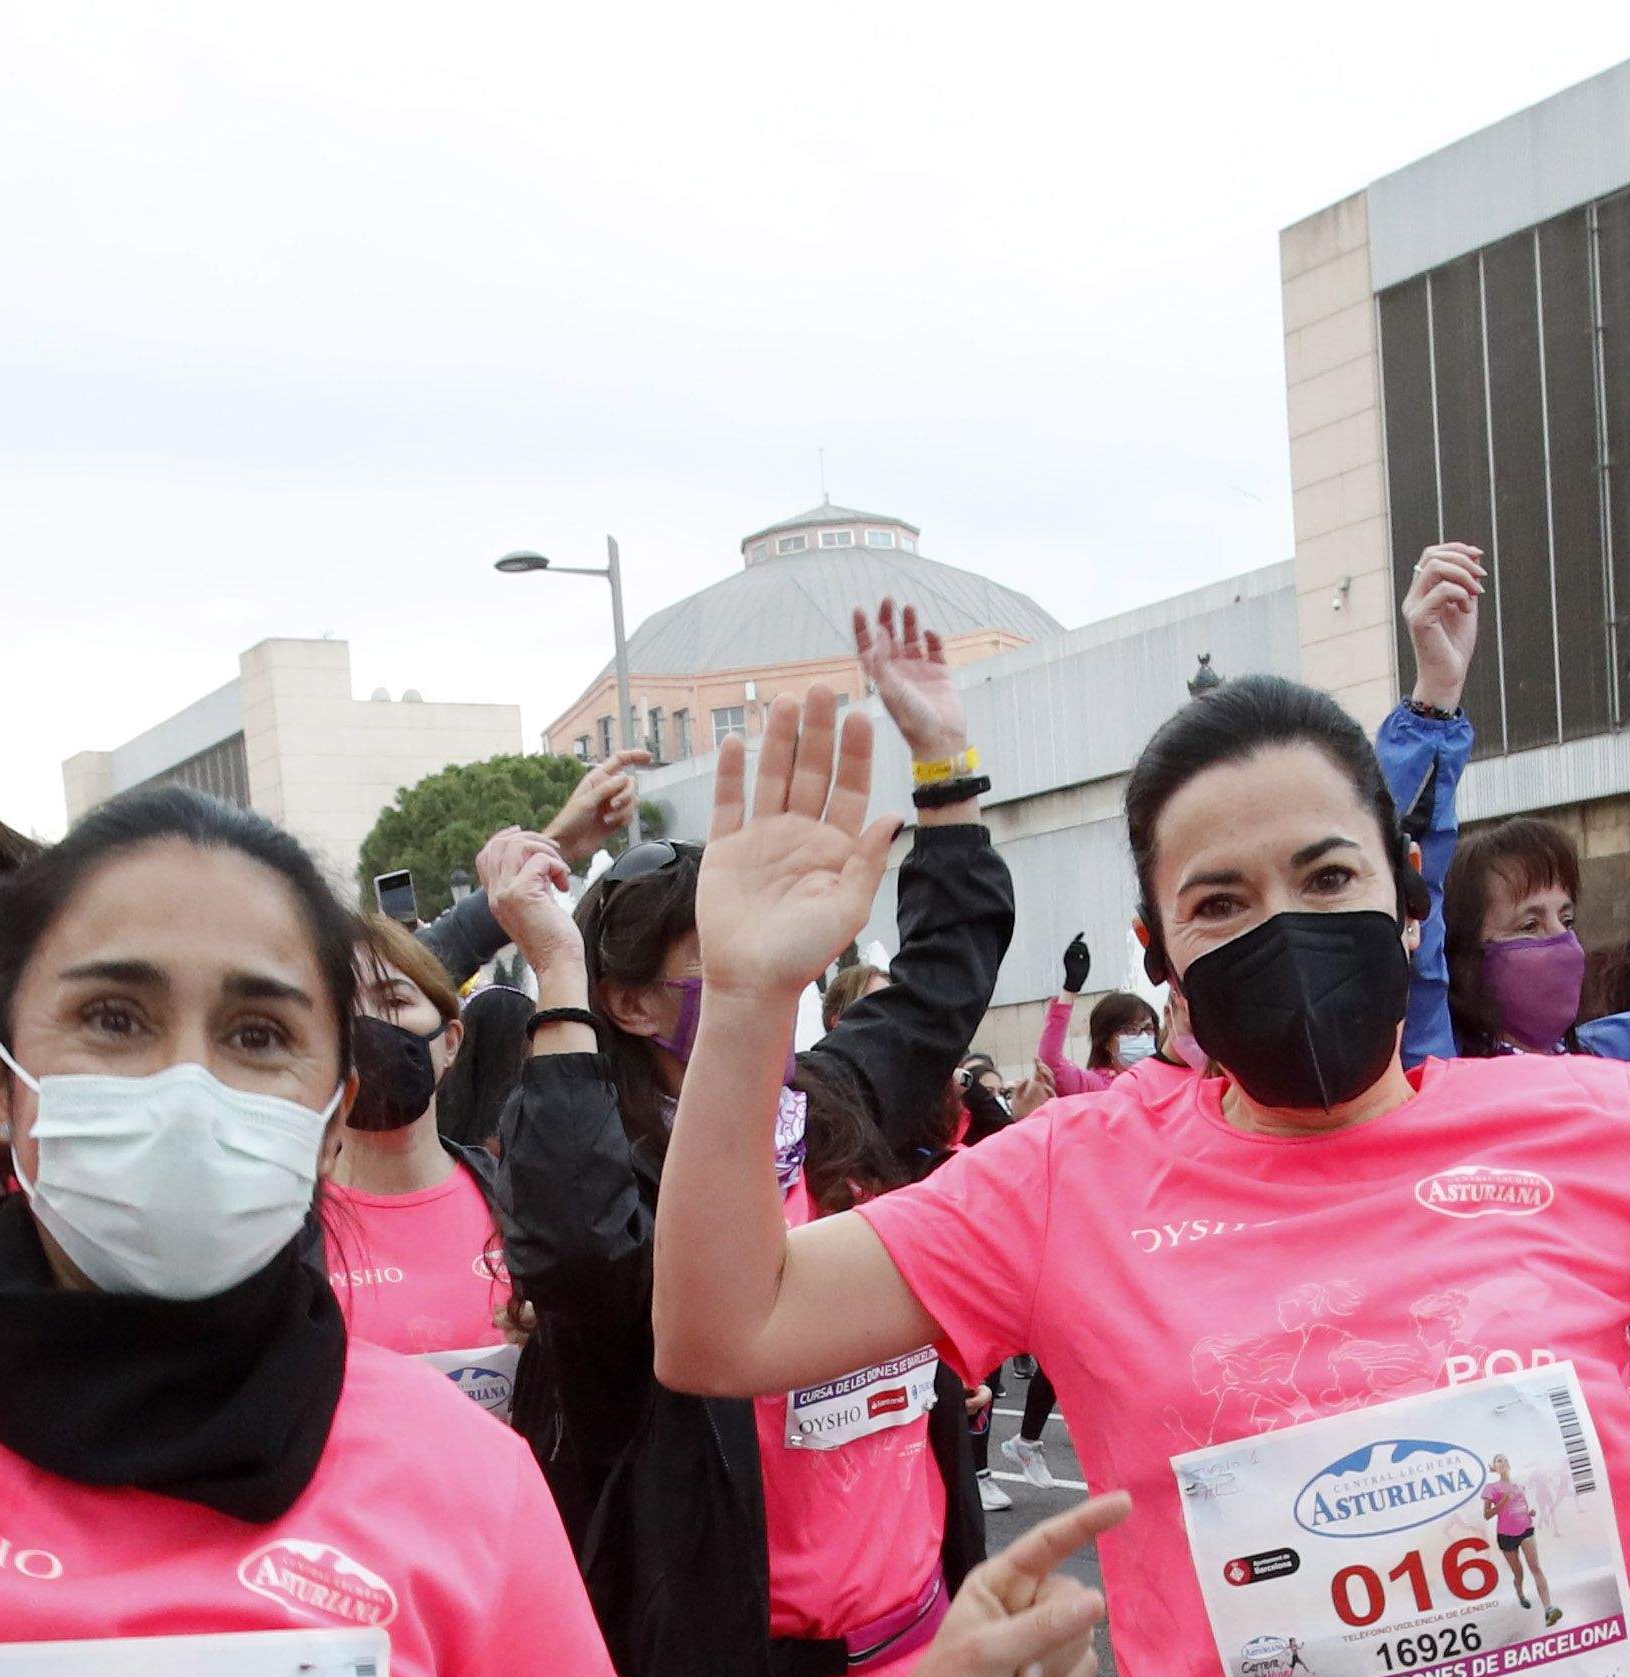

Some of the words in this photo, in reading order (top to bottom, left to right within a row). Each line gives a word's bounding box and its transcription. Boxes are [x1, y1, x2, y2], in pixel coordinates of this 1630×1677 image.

[1430, 1180, 1542, 1207] ASTURIANA
[799, 1386, 834, 1405] CURSA
[836, 1381, 850, 1396] DE
[851, 1372, 866, 1389] LES
[799, 1406, 861, 1435] OYSHO
[1333, 1473, 1394, 1494] CENTRAL
[1400, 1456, 1461, 1477] LECHERA
[1312, 1468, 1475, 1526] ASTURIANA
[253, 1554, 381, 1625] ASTURIANA
[1331, 1537, 1499, 1628] 016
[1394, 1614, 1443, 1632] VIOLENCIA
[1446, 1610, 1459, 1620] DE
[1376, 1622, 1482, 1671] 16926
[1504, 1619, 1621, 1669] BARCELONA
